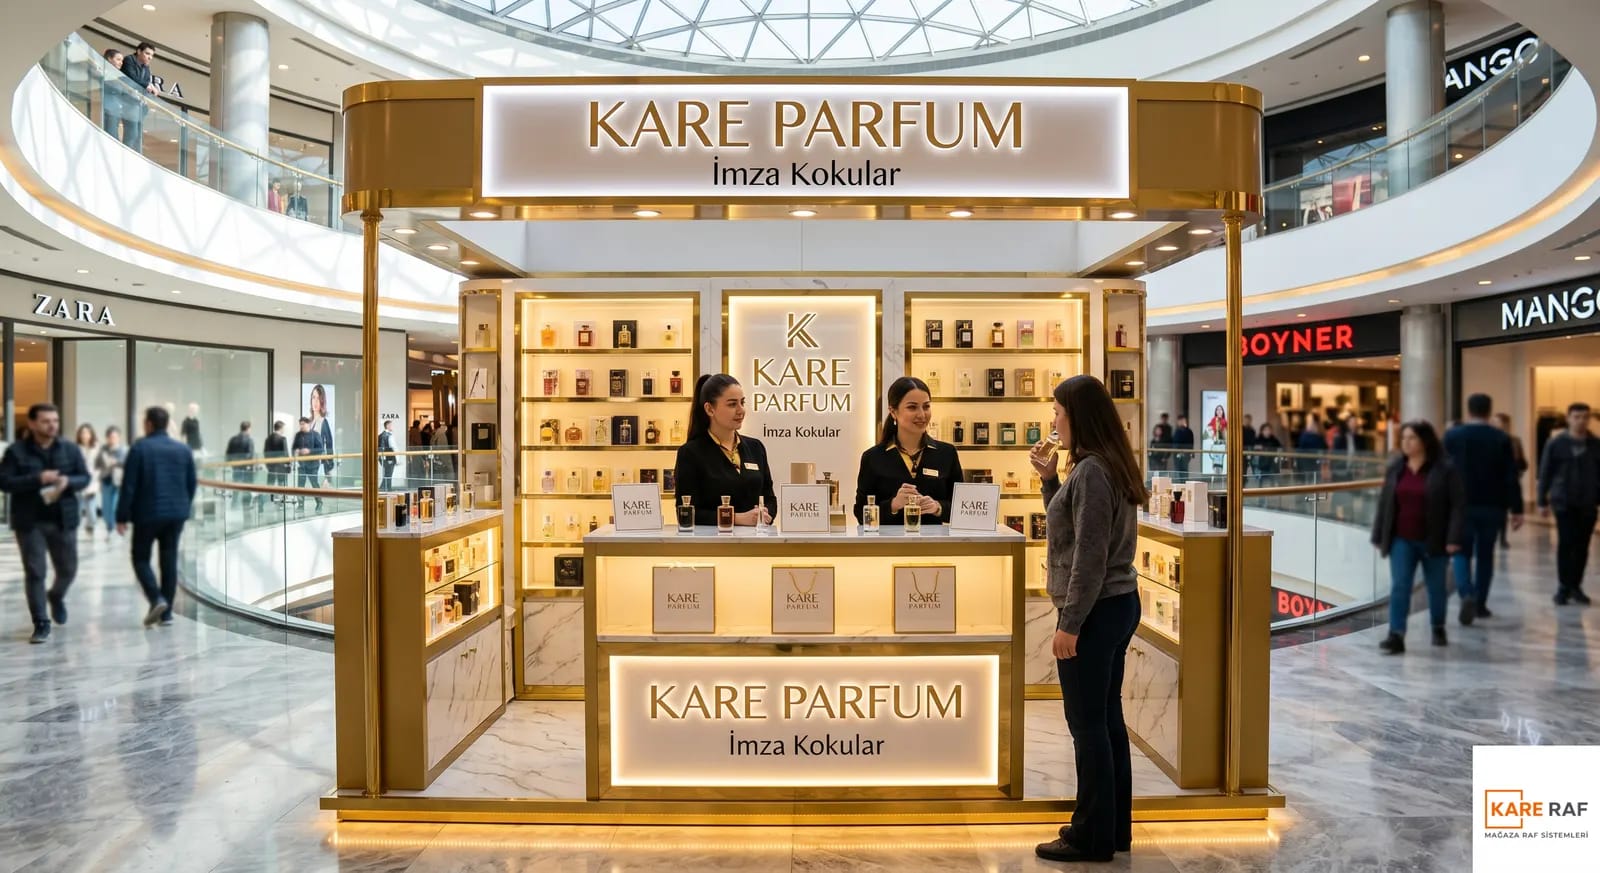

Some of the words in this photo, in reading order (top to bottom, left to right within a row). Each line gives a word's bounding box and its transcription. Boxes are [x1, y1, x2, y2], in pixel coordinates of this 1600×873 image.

[590, 100, 750, 148] KARE
[775, 100, 1022, 149] PARFUM
[713, 155, 780, 186] İmza
[792, 159, 902, 186] Kokular
[32, 293, 116, 327] ZARA
[1501, 286, 1600, 330] MANG
[753, 358, 850, 386] KARE
[753, 393, 851, 412] PARFUM
[763, 423, 791, 438] İmza
[795, 426, 841, 438] Kokular
[623, 500, 652, 509] KARE
[790, 502, 820, 511] KARE
[961, 500, 988, 510] KARE
[667, 592, 700, 603] KARE
[786, 592, 820, 603] KARE
[909, 592, 940, 603] KARE
[650, 685, 767, 719] KARE
[784, 684, 962, 719] PARFUM
[730, 730, 785, 756] İmza
[794, 733, 885, 756] Kokular
